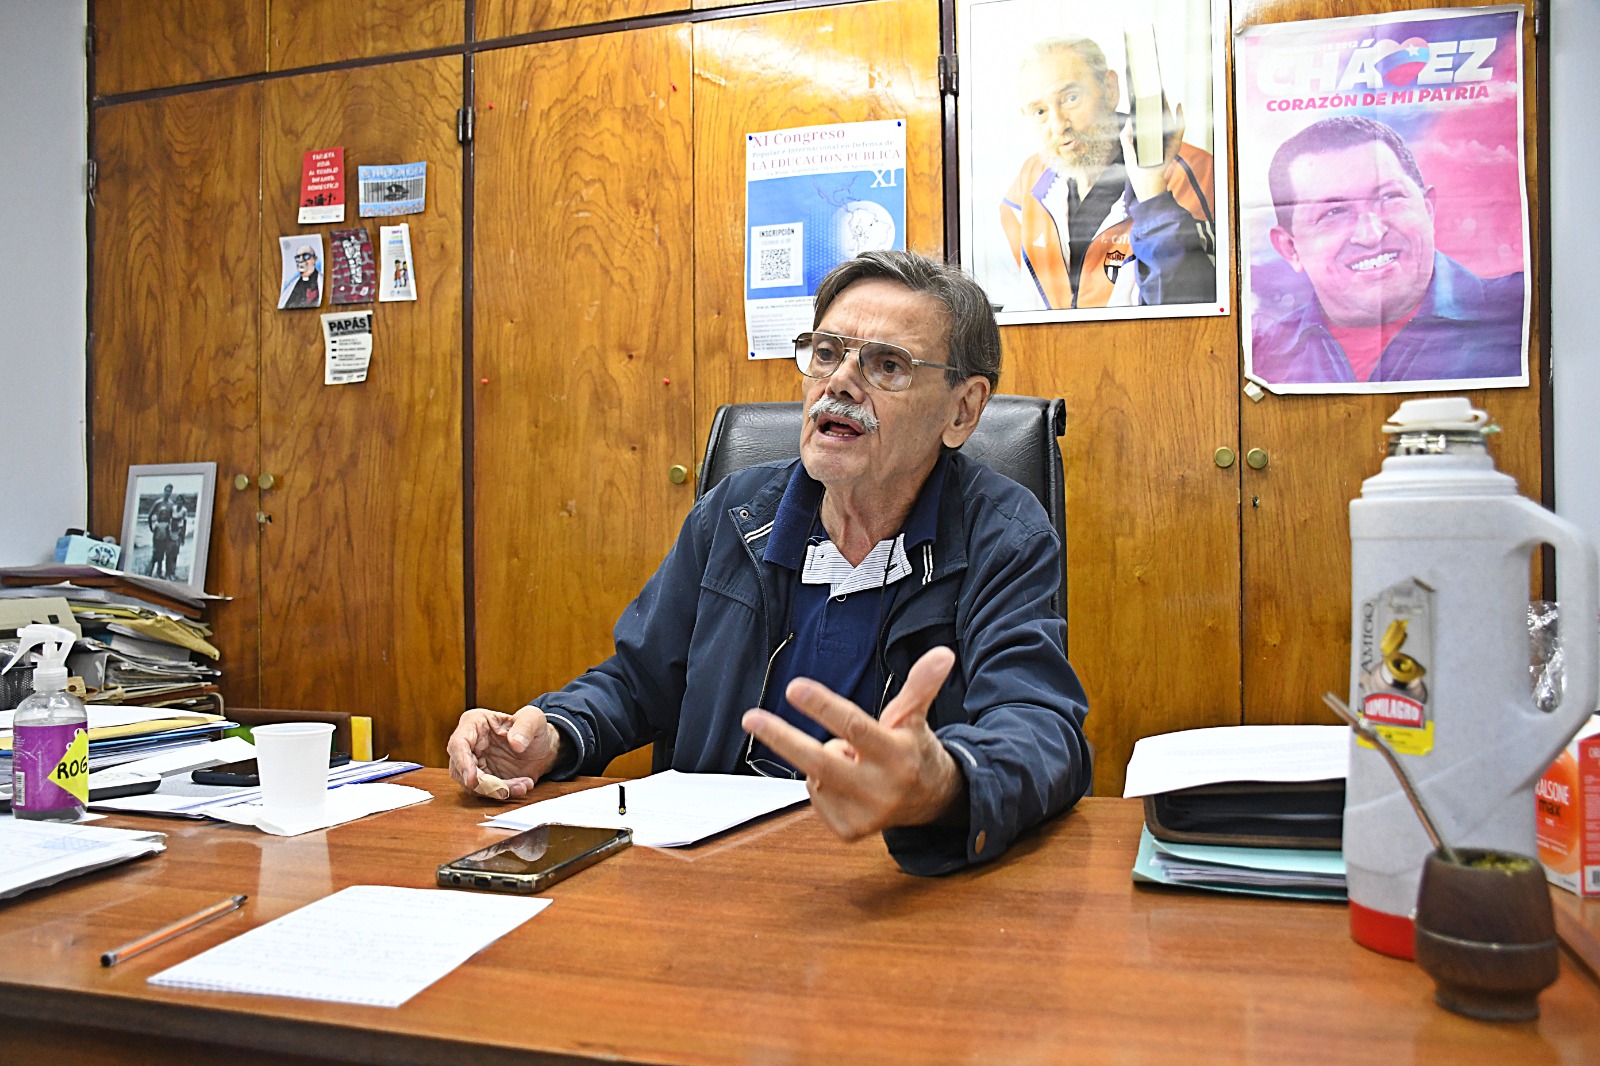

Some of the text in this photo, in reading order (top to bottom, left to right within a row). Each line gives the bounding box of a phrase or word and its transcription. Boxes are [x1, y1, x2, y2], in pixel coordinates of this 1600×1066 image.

[1266, 85, 1490, 112] CORAZÓN DE MI PATRIA
[752, 129, 846, 148] XI Congreso
[752, 161, 767, 172] LA
[870, 169, 898, 188] XI
